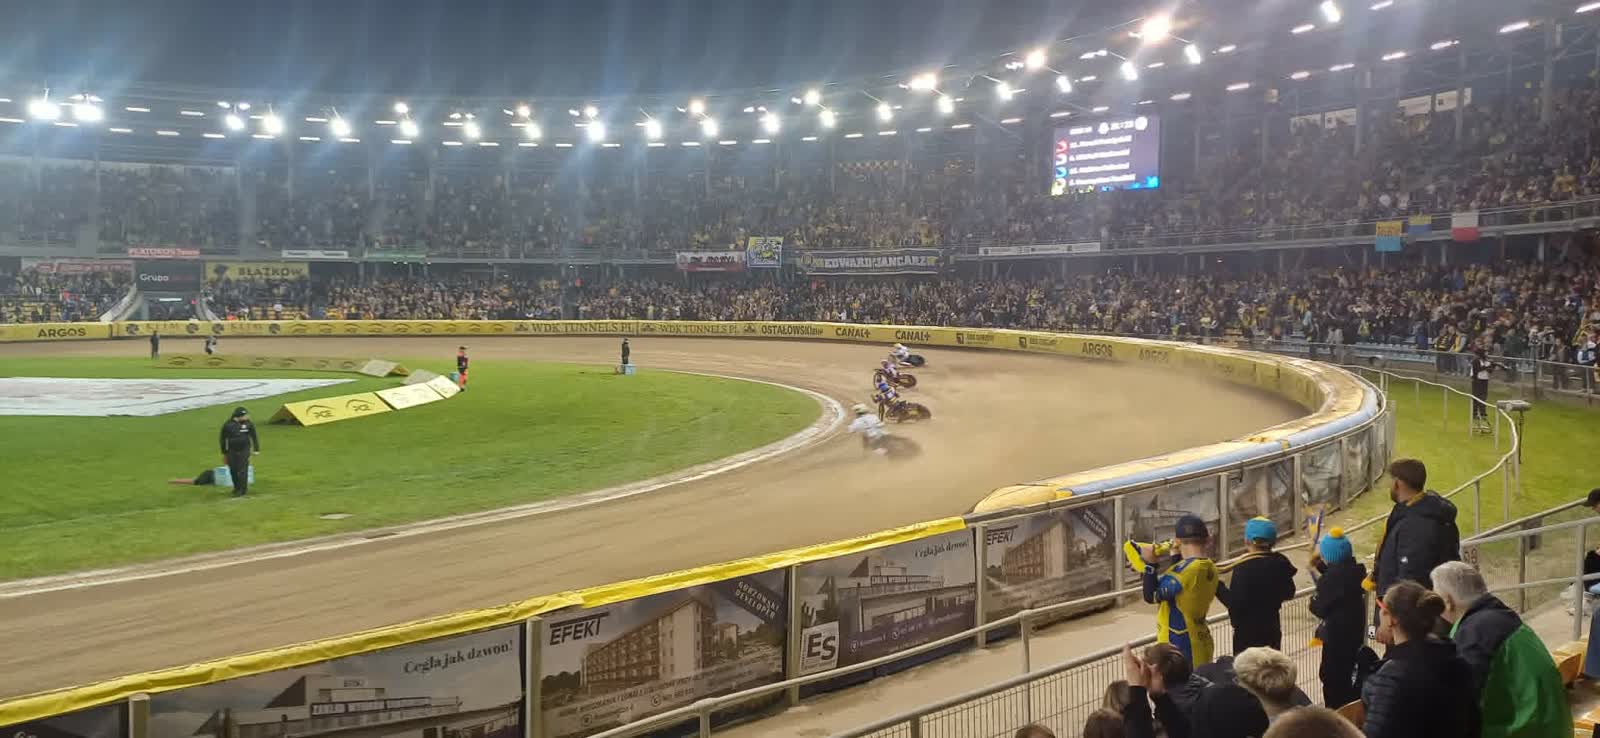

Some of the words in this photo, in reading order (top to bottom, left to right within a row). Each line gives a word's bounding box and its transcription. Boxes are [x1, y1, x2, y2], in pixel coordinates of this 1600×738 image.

[37, 327, 87, 338] ARGOS
[564, 322, 618, 333] TUNNELS
[835, 327, 871, 339] CANAL+
[895, 330, 931, 342] CANAL+
[1082, 341, 1113, 358] ARGOS
[549, 611, 610, 646] EFEKT
[807, 632, 836, 661] ES
[442, 650, 465, 670] jak
